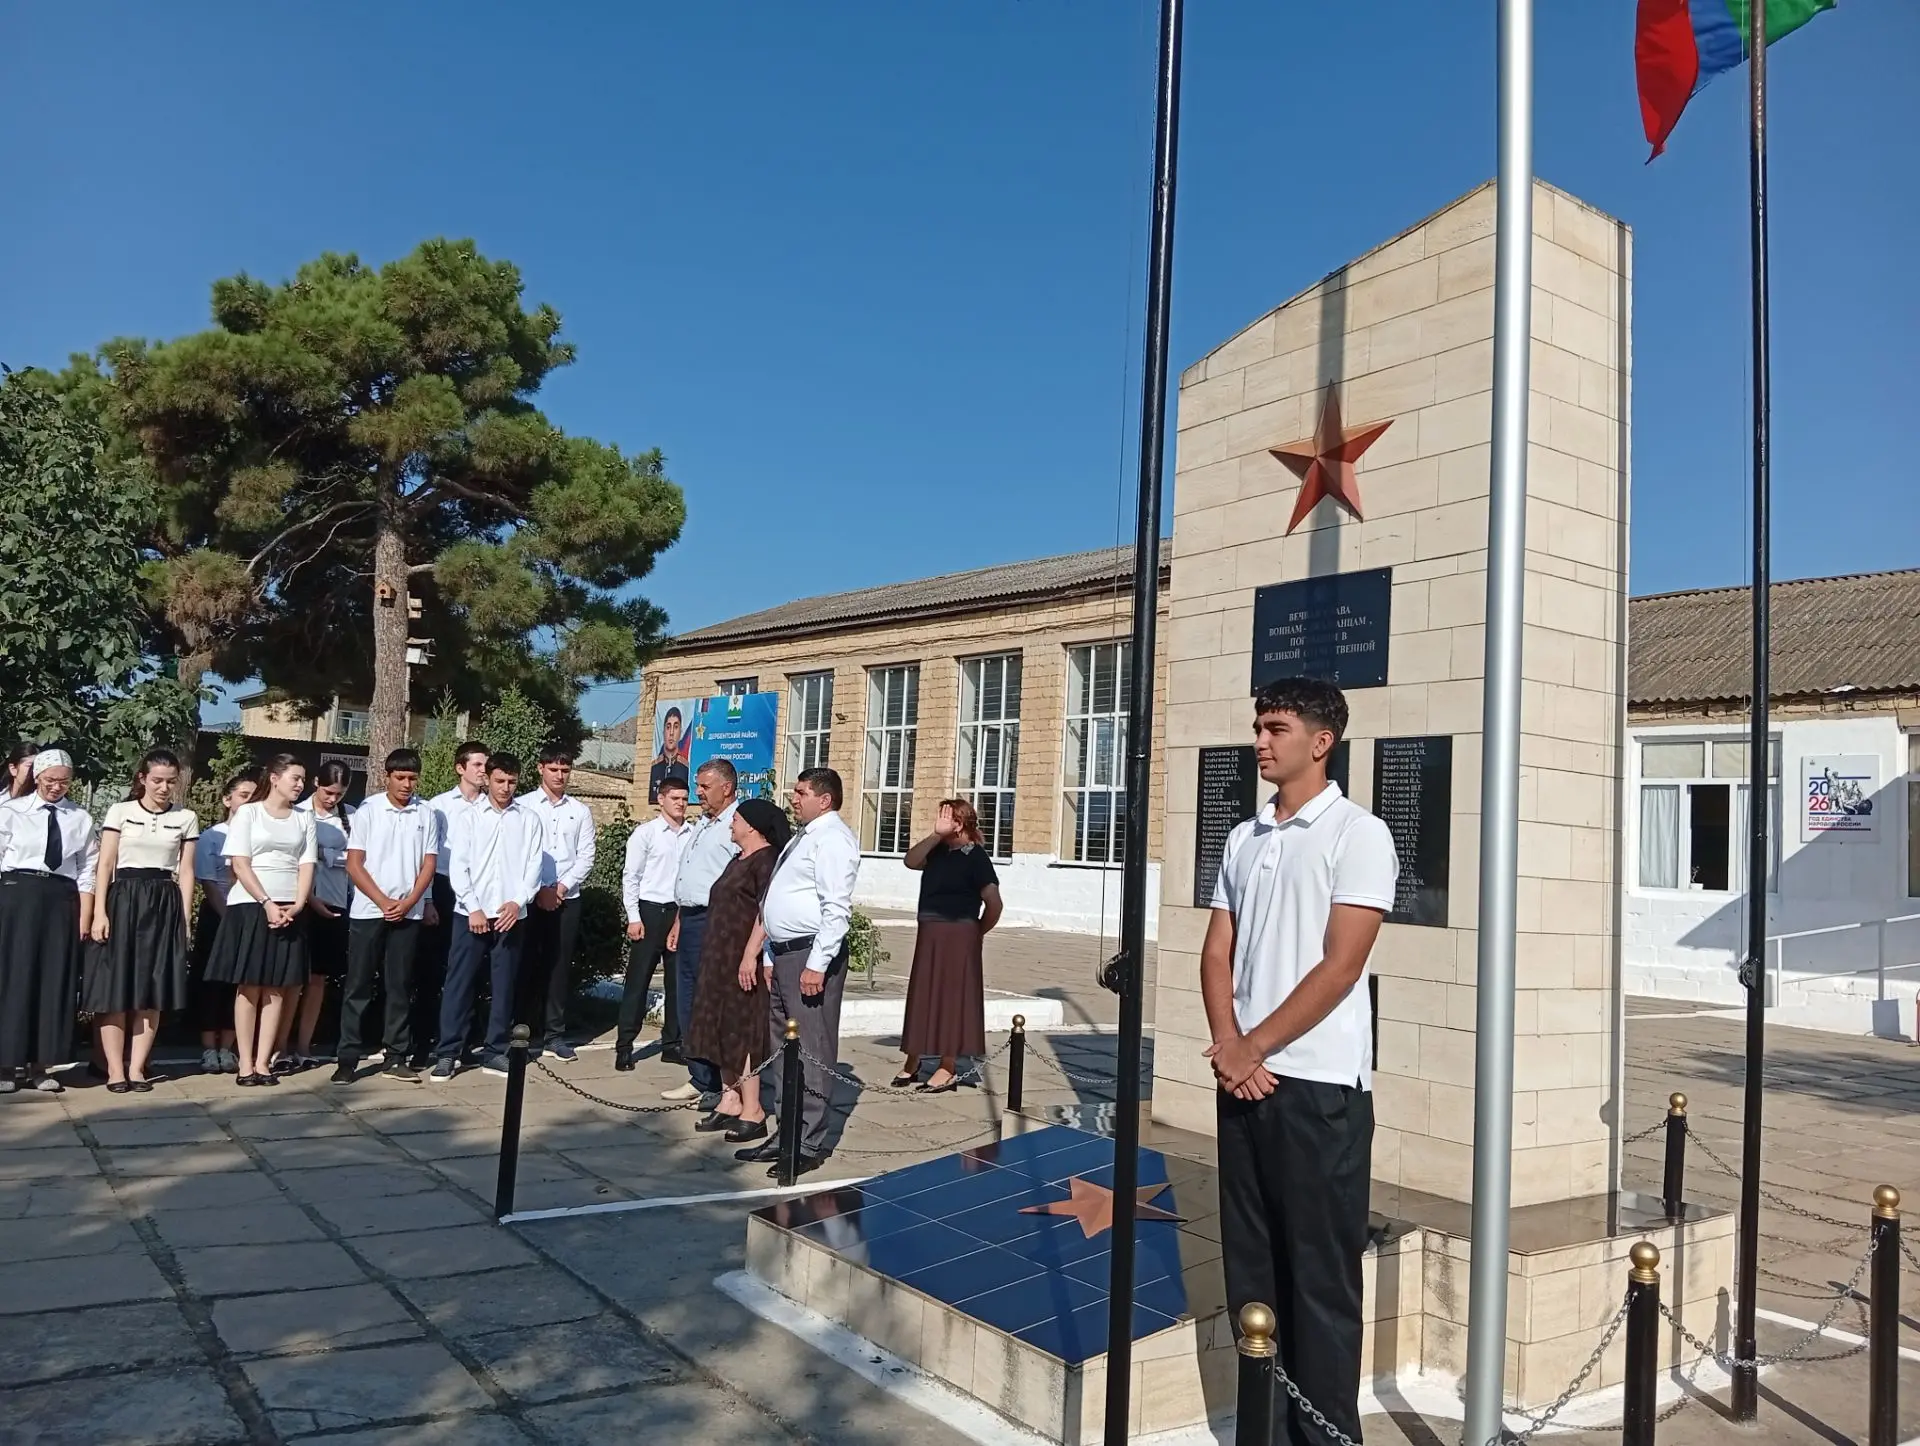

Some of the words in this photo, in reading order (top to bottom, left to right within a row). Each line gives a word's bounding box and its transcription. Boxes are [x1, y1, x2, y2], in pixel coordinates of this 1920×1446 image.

[1264, 649, 1301, 662] ВЕЛИКОЙ
[741, 730, 758, 738] РАЙОН
[1808, 781, 1829, 795] 20
[1808, 796, 1829, 811] 26
